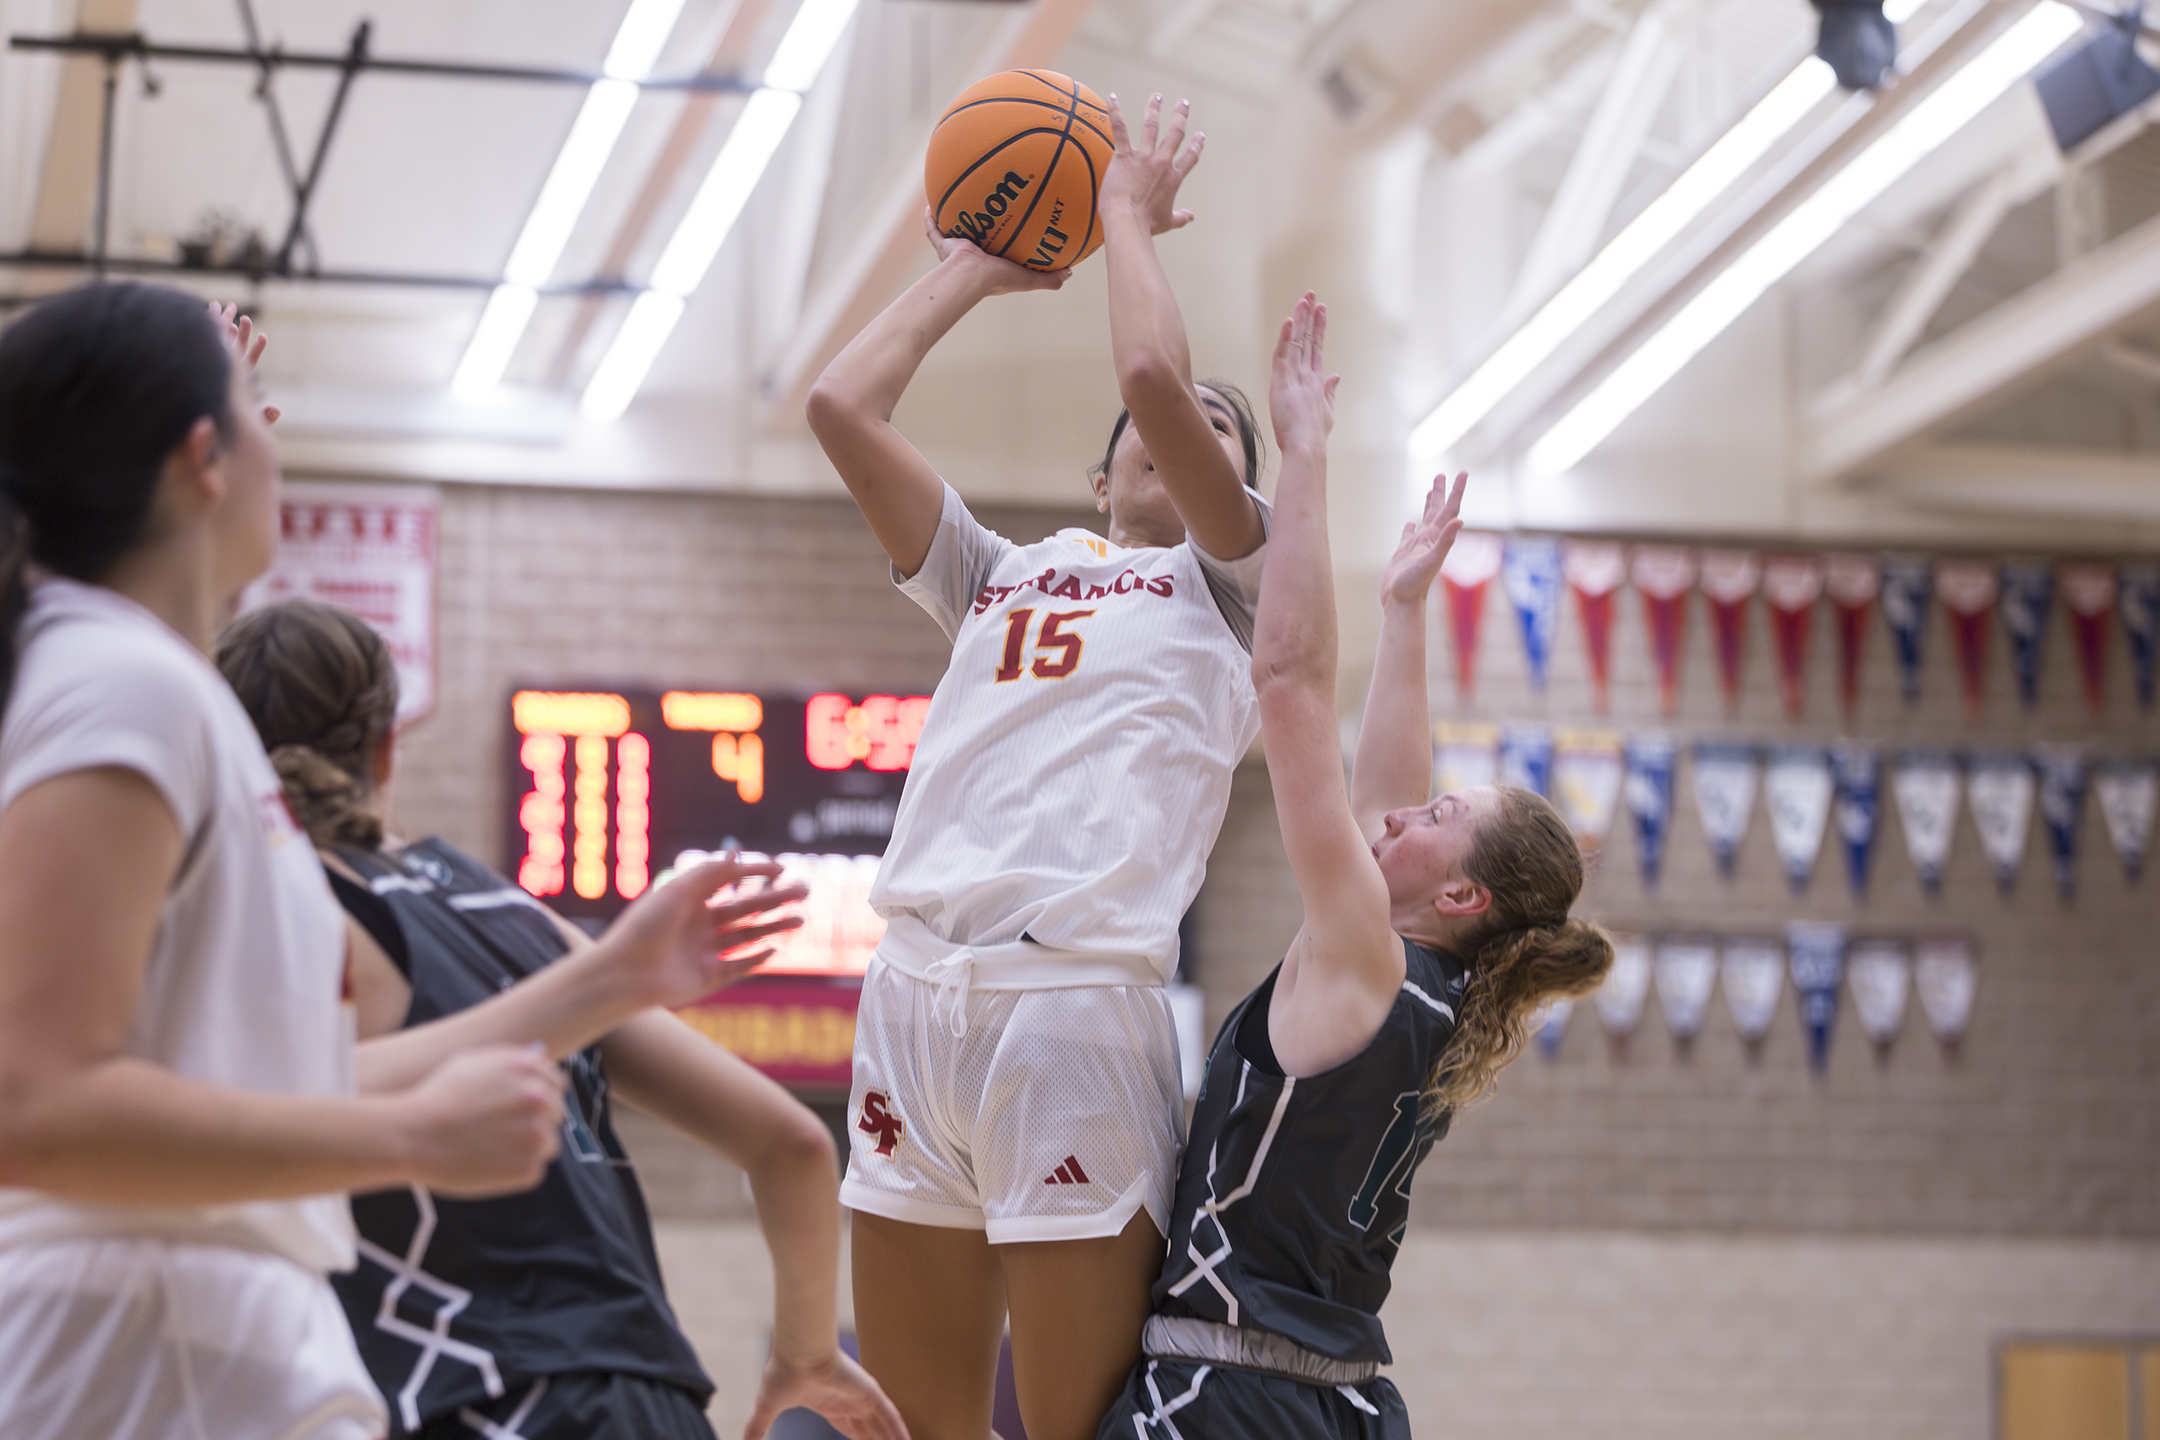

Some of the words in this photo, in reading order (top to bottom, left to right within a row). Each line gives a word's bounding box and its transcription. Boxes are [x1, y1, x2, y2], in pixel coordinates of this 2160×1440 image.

[1049, 197, 1065, 226] NXT
[1023, 226, 1068, 273] VO
[995, 607, 1098, 684] 15
